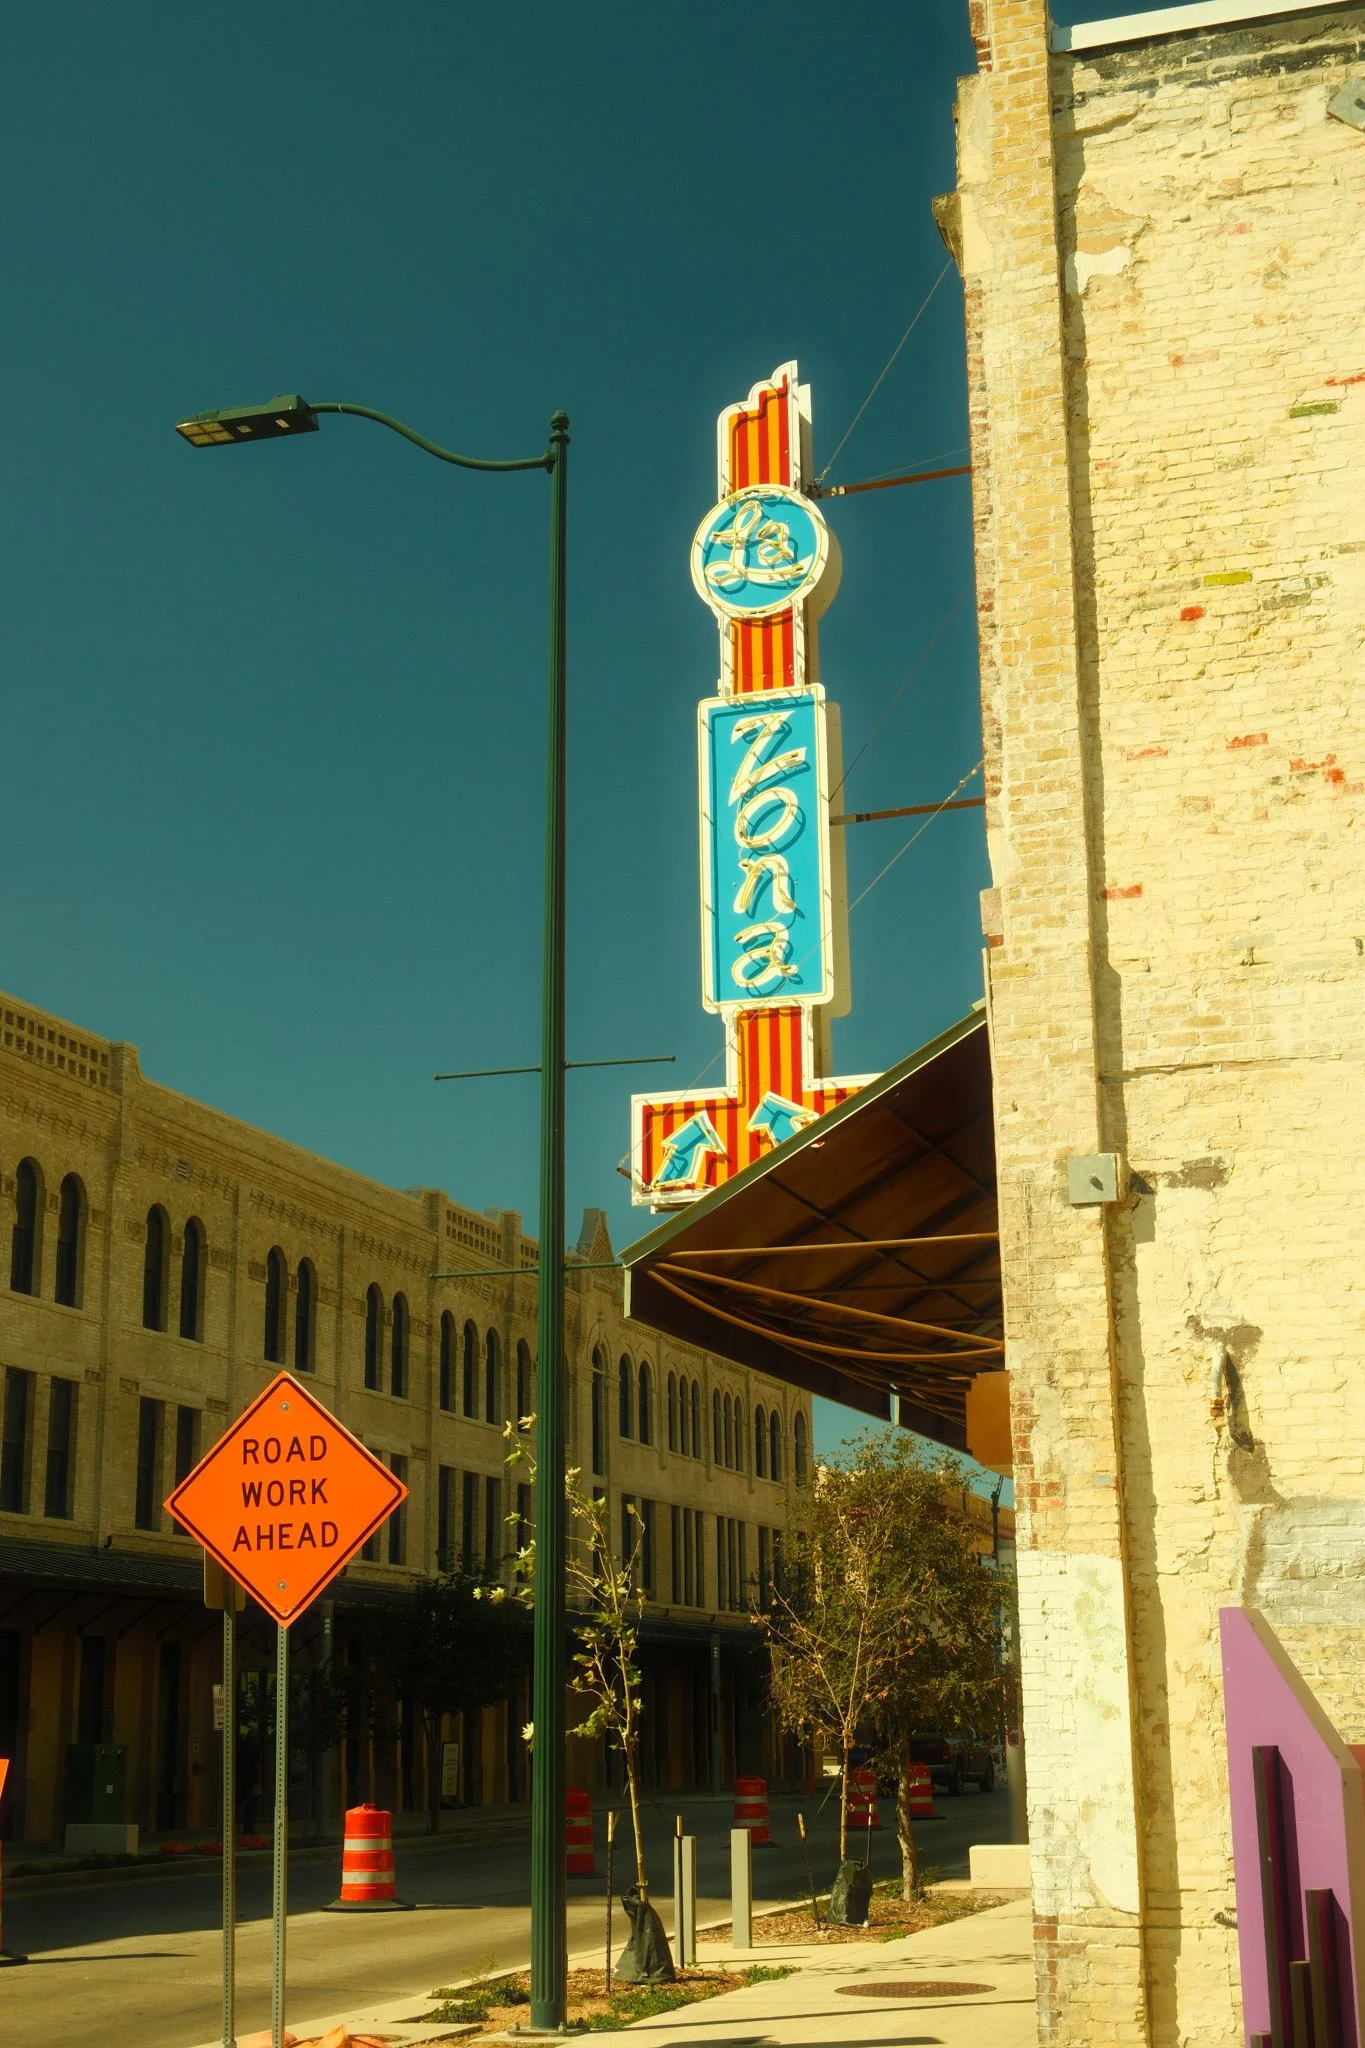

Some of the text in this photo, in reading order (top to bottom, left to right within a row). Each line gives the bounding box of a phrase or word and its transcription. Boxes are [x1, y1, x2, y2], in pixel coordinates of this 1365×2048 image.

[704, 500, 814, 586] La
[728, 710, 807, 988] Zona
[242, 1435, 328, 1465] ROAD
[241, 1477, 329, 1508] WORK
[232, 1521, 339, 1552] AHEAD
